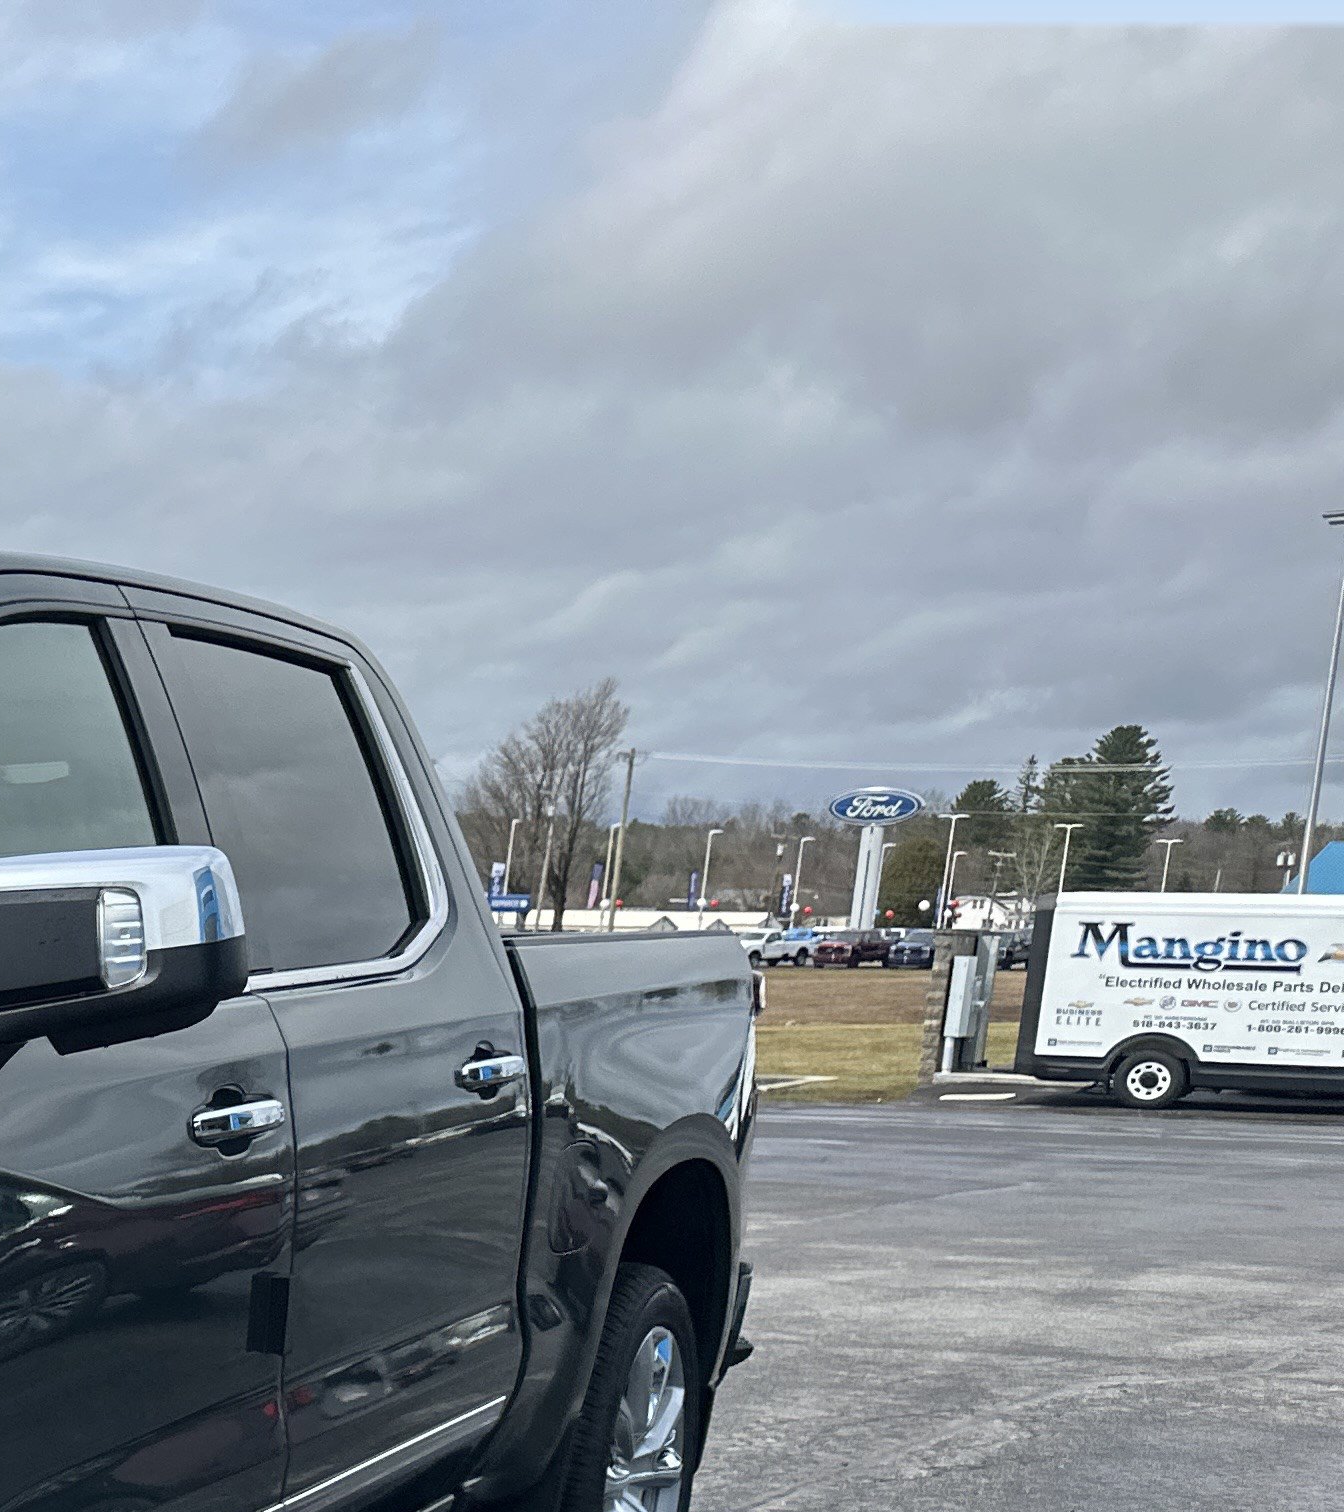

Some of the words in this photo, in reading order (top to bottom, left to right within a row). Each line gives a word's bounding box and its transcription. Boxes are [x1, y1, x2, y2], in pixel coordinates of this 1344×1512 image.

[846, 795, 903, 818] Ford
[1071, 921, 1308, 975] Mangino
[1187, 978, 1268, 992] Wholesale
[1273, 980, 1314, 993] Parts
[1180, 999, 1219, 1009] GMC
[1248, 1000, 1306, 1012] Certified
[1055, 1015, 1102, 1027] ELITE
